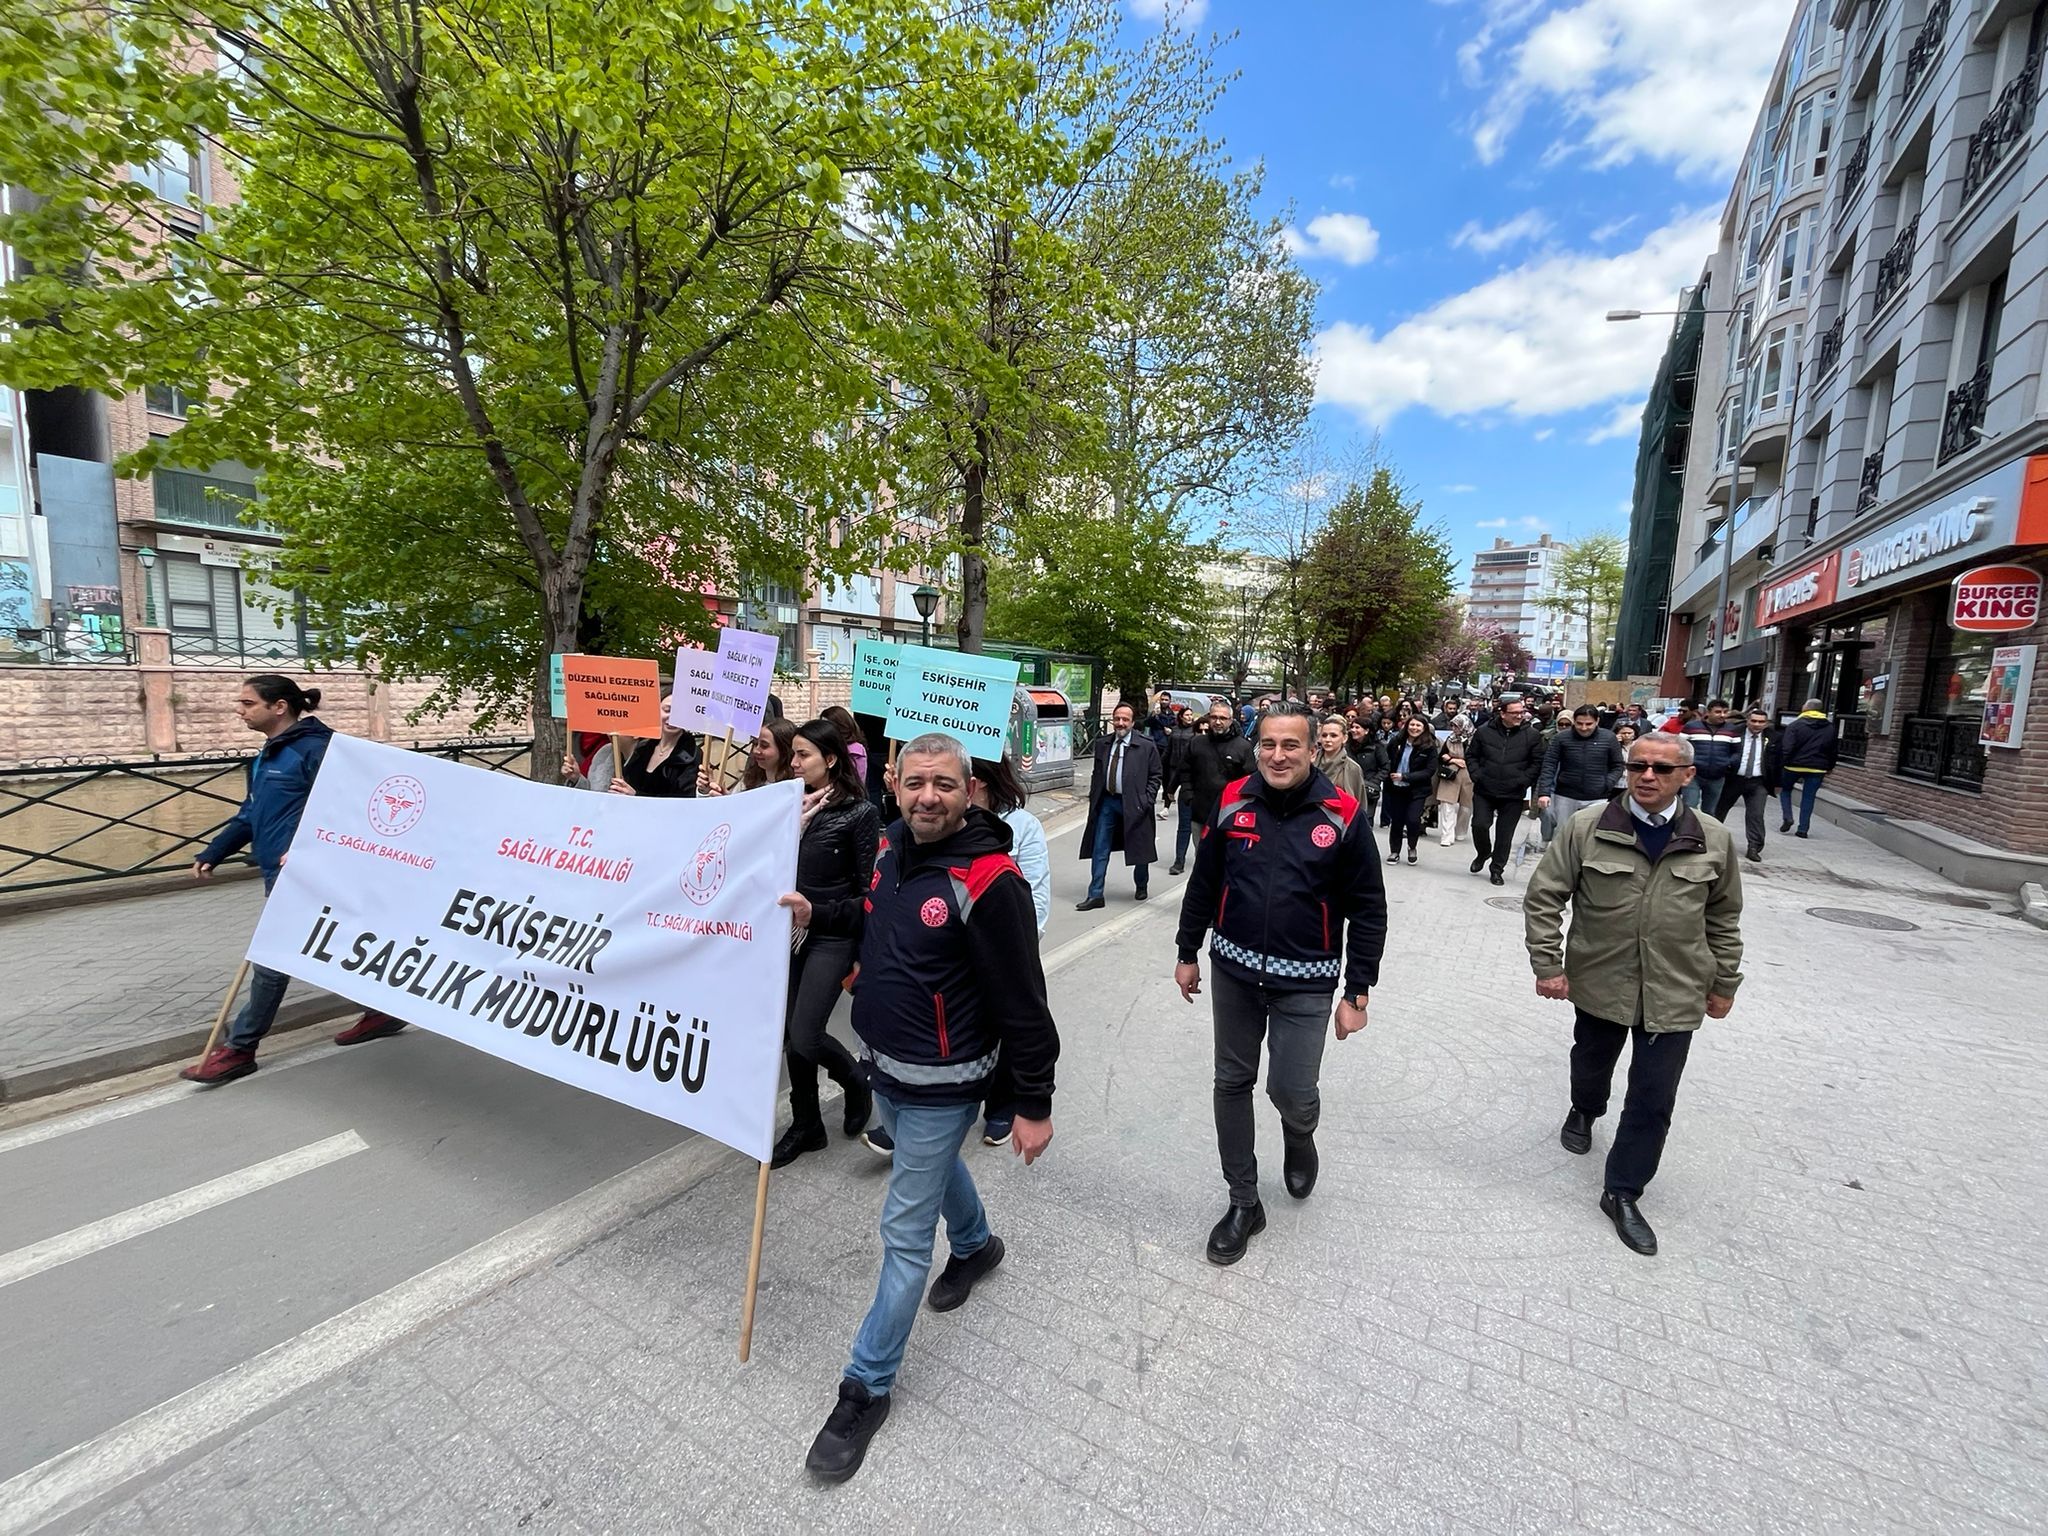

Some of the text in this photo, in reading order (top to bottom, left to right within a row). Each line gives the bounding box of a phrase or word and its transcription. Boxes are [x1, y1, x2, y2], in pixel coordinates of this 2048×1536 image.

[1923, 496, 1988, 558] KING
[1958, 586, 2039, 600] BURGER
[1956, 599, 2037, 618] KING
[883, 658, 899, 667] OK
[568, 673, 607, 684] DÜZENLİ
[609, 676, 655, 688] EGZERSİZ
[864, 668, 884, 678] HER
[922, 671, 987, 692] ESKİŞEHİR
[750, 678, 759, 688] ET
[859, 679, 891, 693] BUDUR
[584, 691, 640, 703] SAĞLIĞINIZI
[734, 698, 754, 712] TERCİH
[753, 705, 762, 715] ET
[922, 692, 979, 712] YÜRÜYOR
[597, 708, 629, 718] KORUR
[894, 706, 1001, 738] YÜZLER GÜLÜYOR
[568, 826, 594, 849] T.C.
[315, 828, 437, 871] T.C. SAĞLIK BAKANLIĞI
[497, 837, 634, 883] SAĞLIK BAKANLIĞI
[439, 887, 613, 975] ESKİŞEHİR
[647, 912, 753, 942] T.C. SAĞLIK BAKANLIĞI
[301, 904, 711, 1095] İL SAĞLIK MÜDÜRLÜĞÜ
